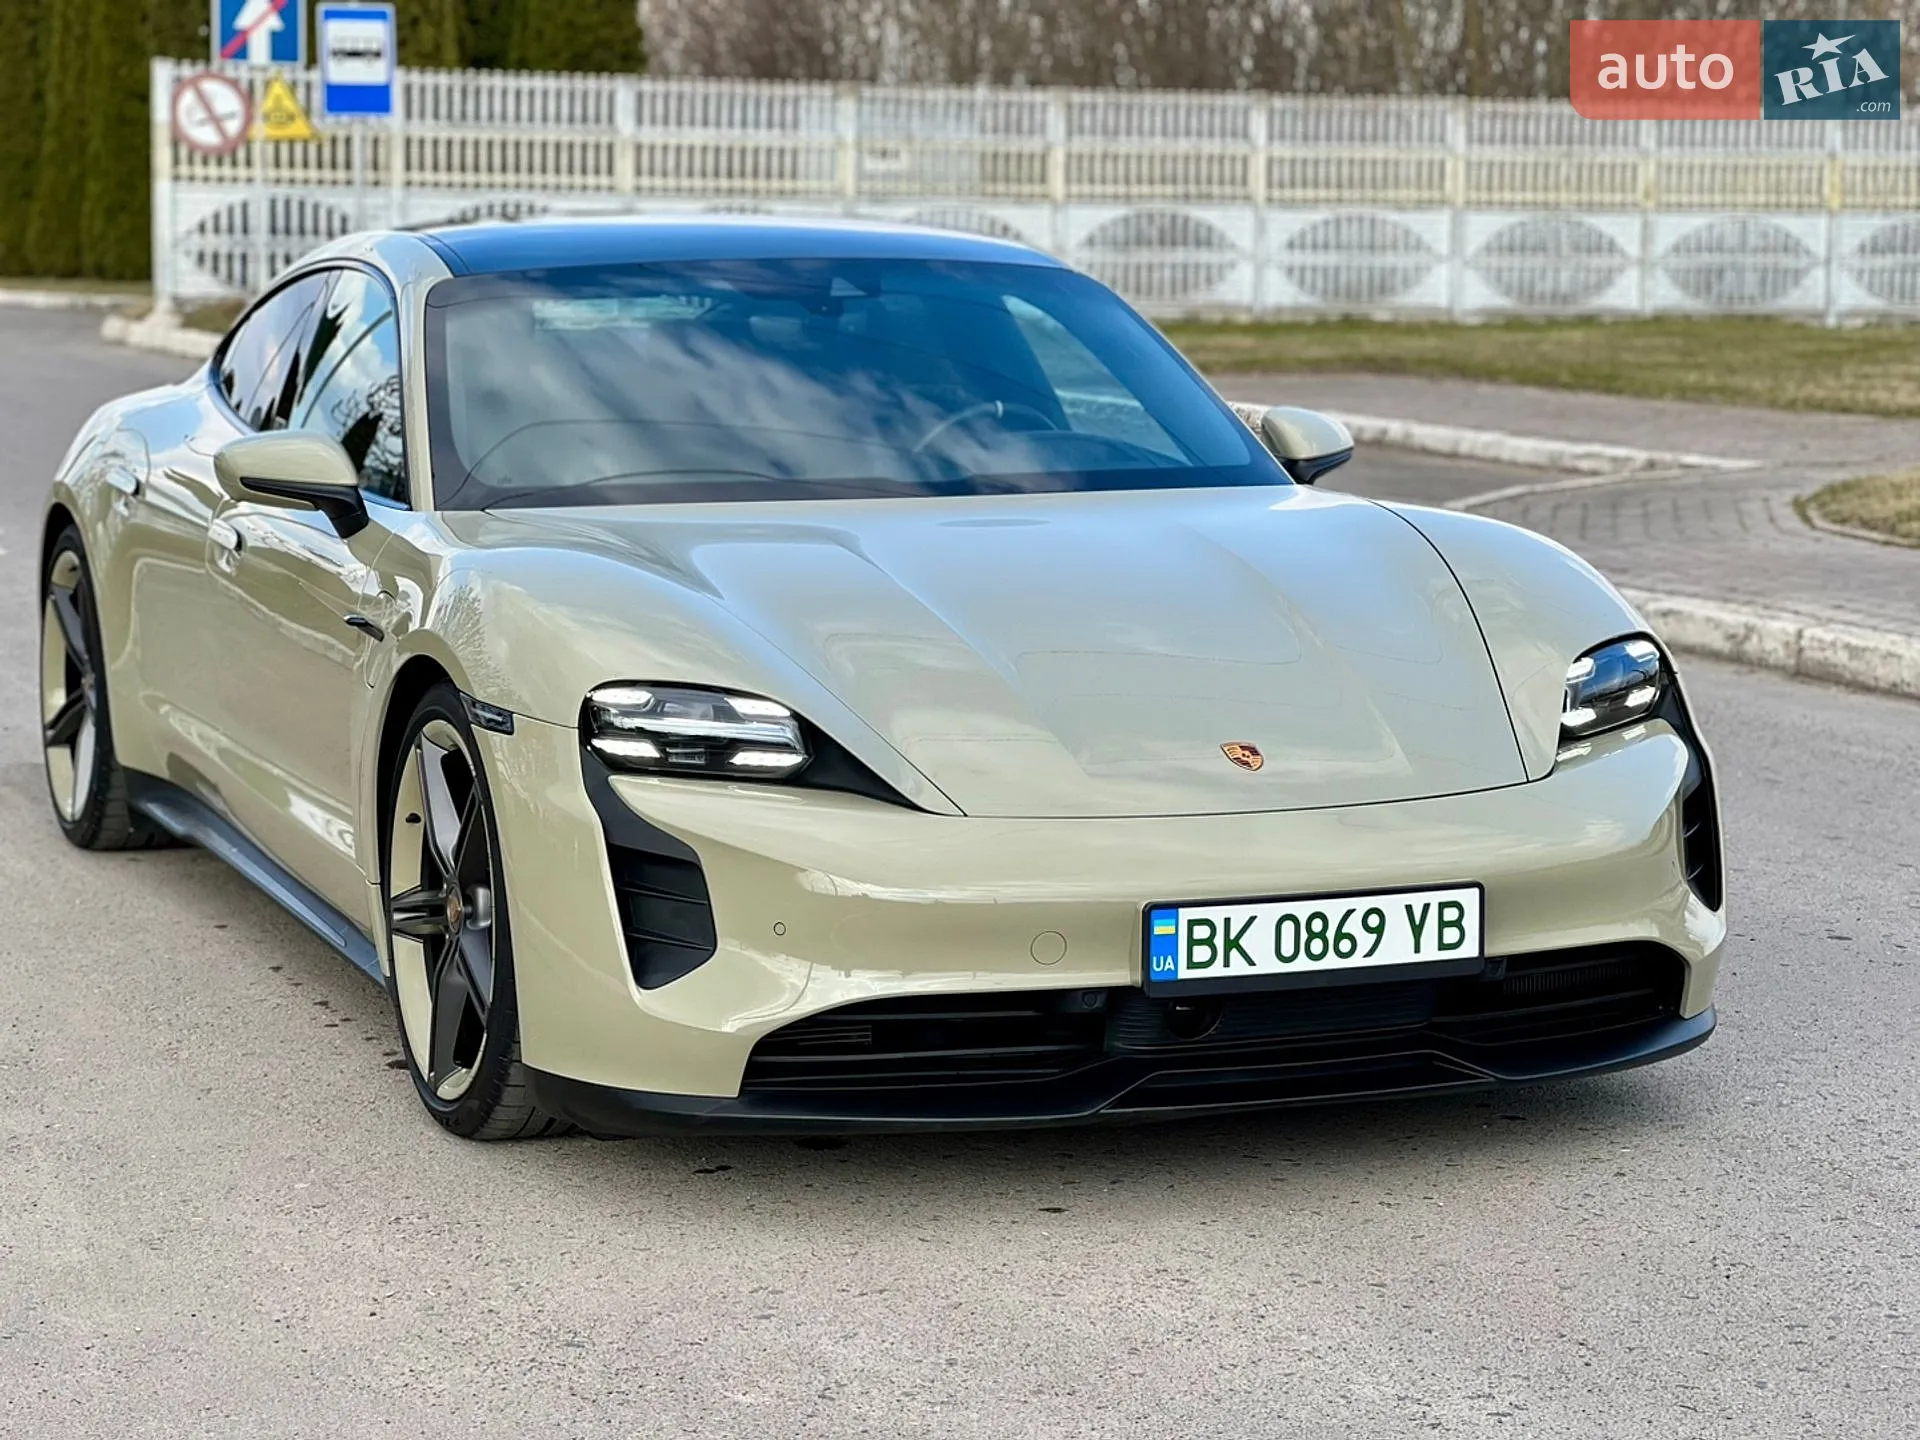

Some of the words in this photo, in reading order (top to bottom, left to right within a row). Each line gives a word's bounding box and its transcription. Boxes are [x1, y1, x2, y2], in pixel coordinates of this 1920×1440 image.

[1186, 915, 1258, 970] BK
[1275, 907, 1386, 963] 0869
[1404, 900, 1466, 954] YB
[1152, 956, 1175, 972] UA
